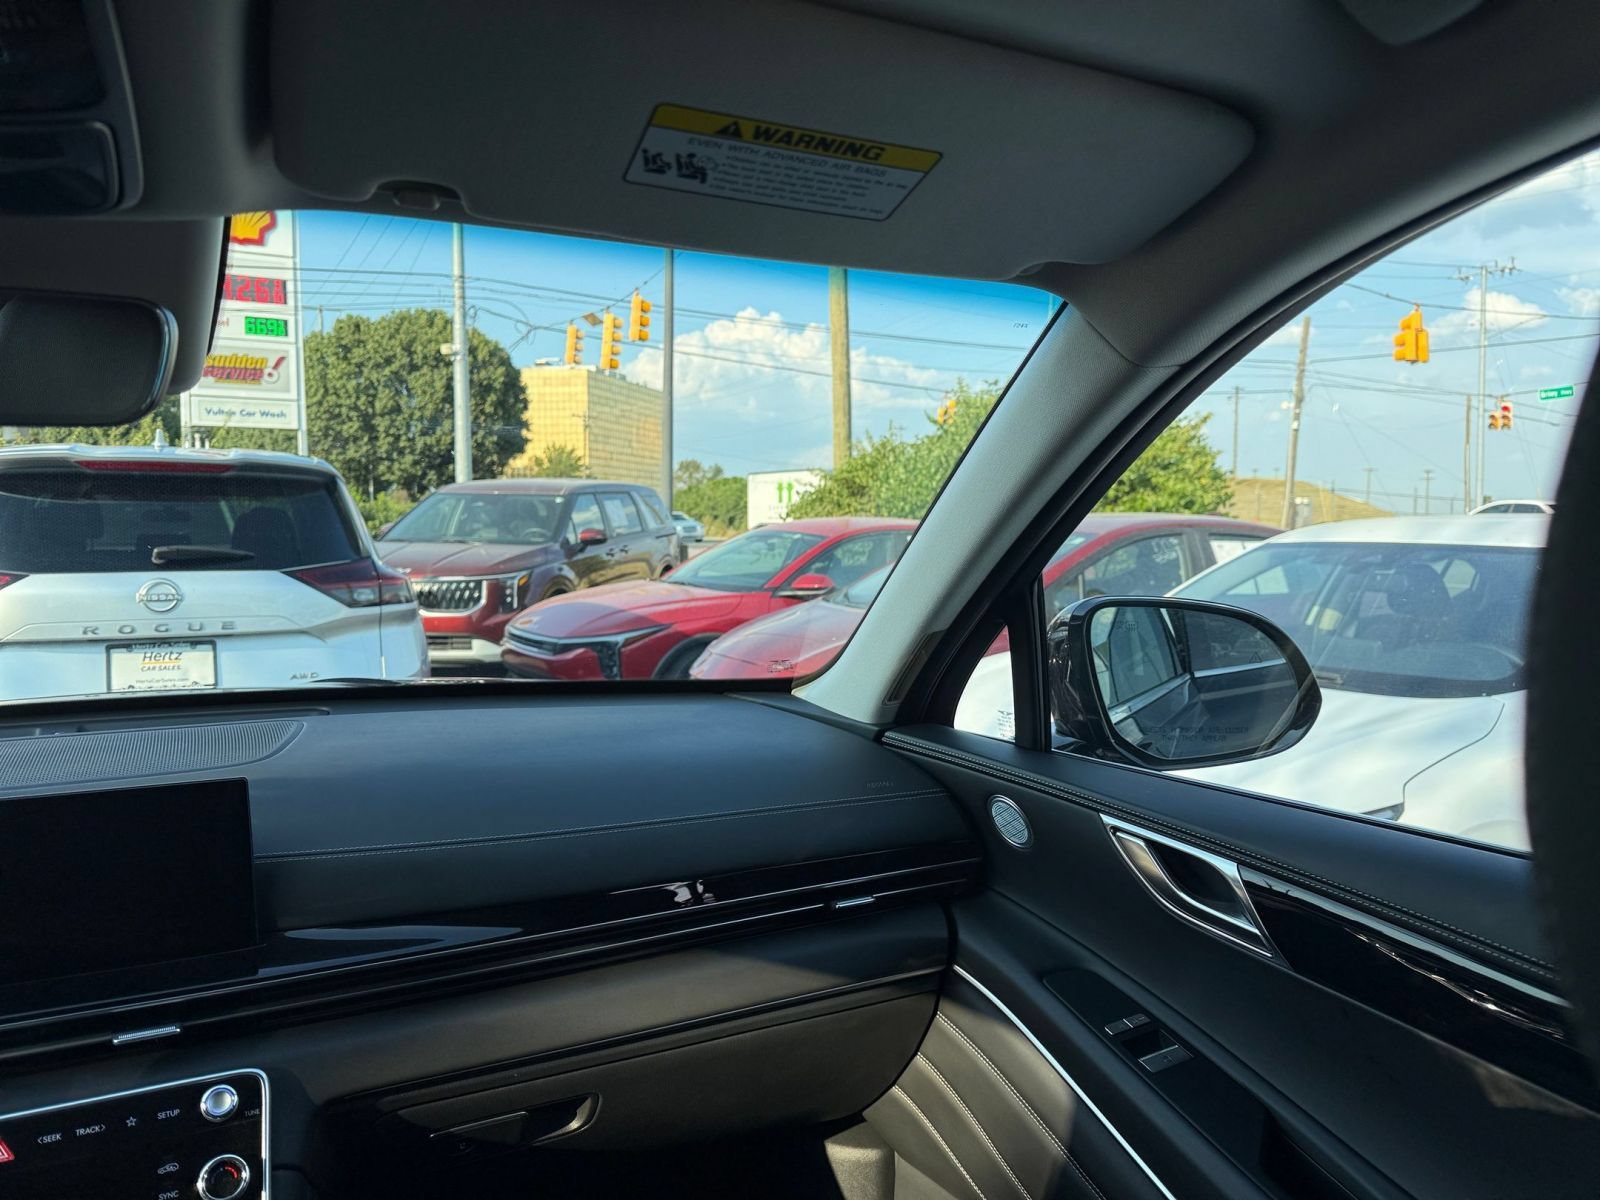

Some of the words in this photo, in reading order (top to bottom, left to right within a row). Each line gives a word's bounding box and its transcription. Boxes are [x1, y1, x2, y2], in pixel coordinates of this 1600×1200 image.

[752, 124, 886, 161] WARNING
[687, 136, 724, 150] EVEN
[727, 143, 760, 154] WITH
[761, 149, 828, 168] ADVANCED
[239, 408, 257, 416] Car
[137, 592, 182, 603] NISSAN
[82, 620, 237, 635] ROGUE
[142, 651, 183, 662] Hertz
[289, 671, 319, 680] AWD
[157, 1109, 180, 1120] SETUP
[244, 1108, 260, 1117] TUNE
[158, 1190, 179, 1200] SYNC
